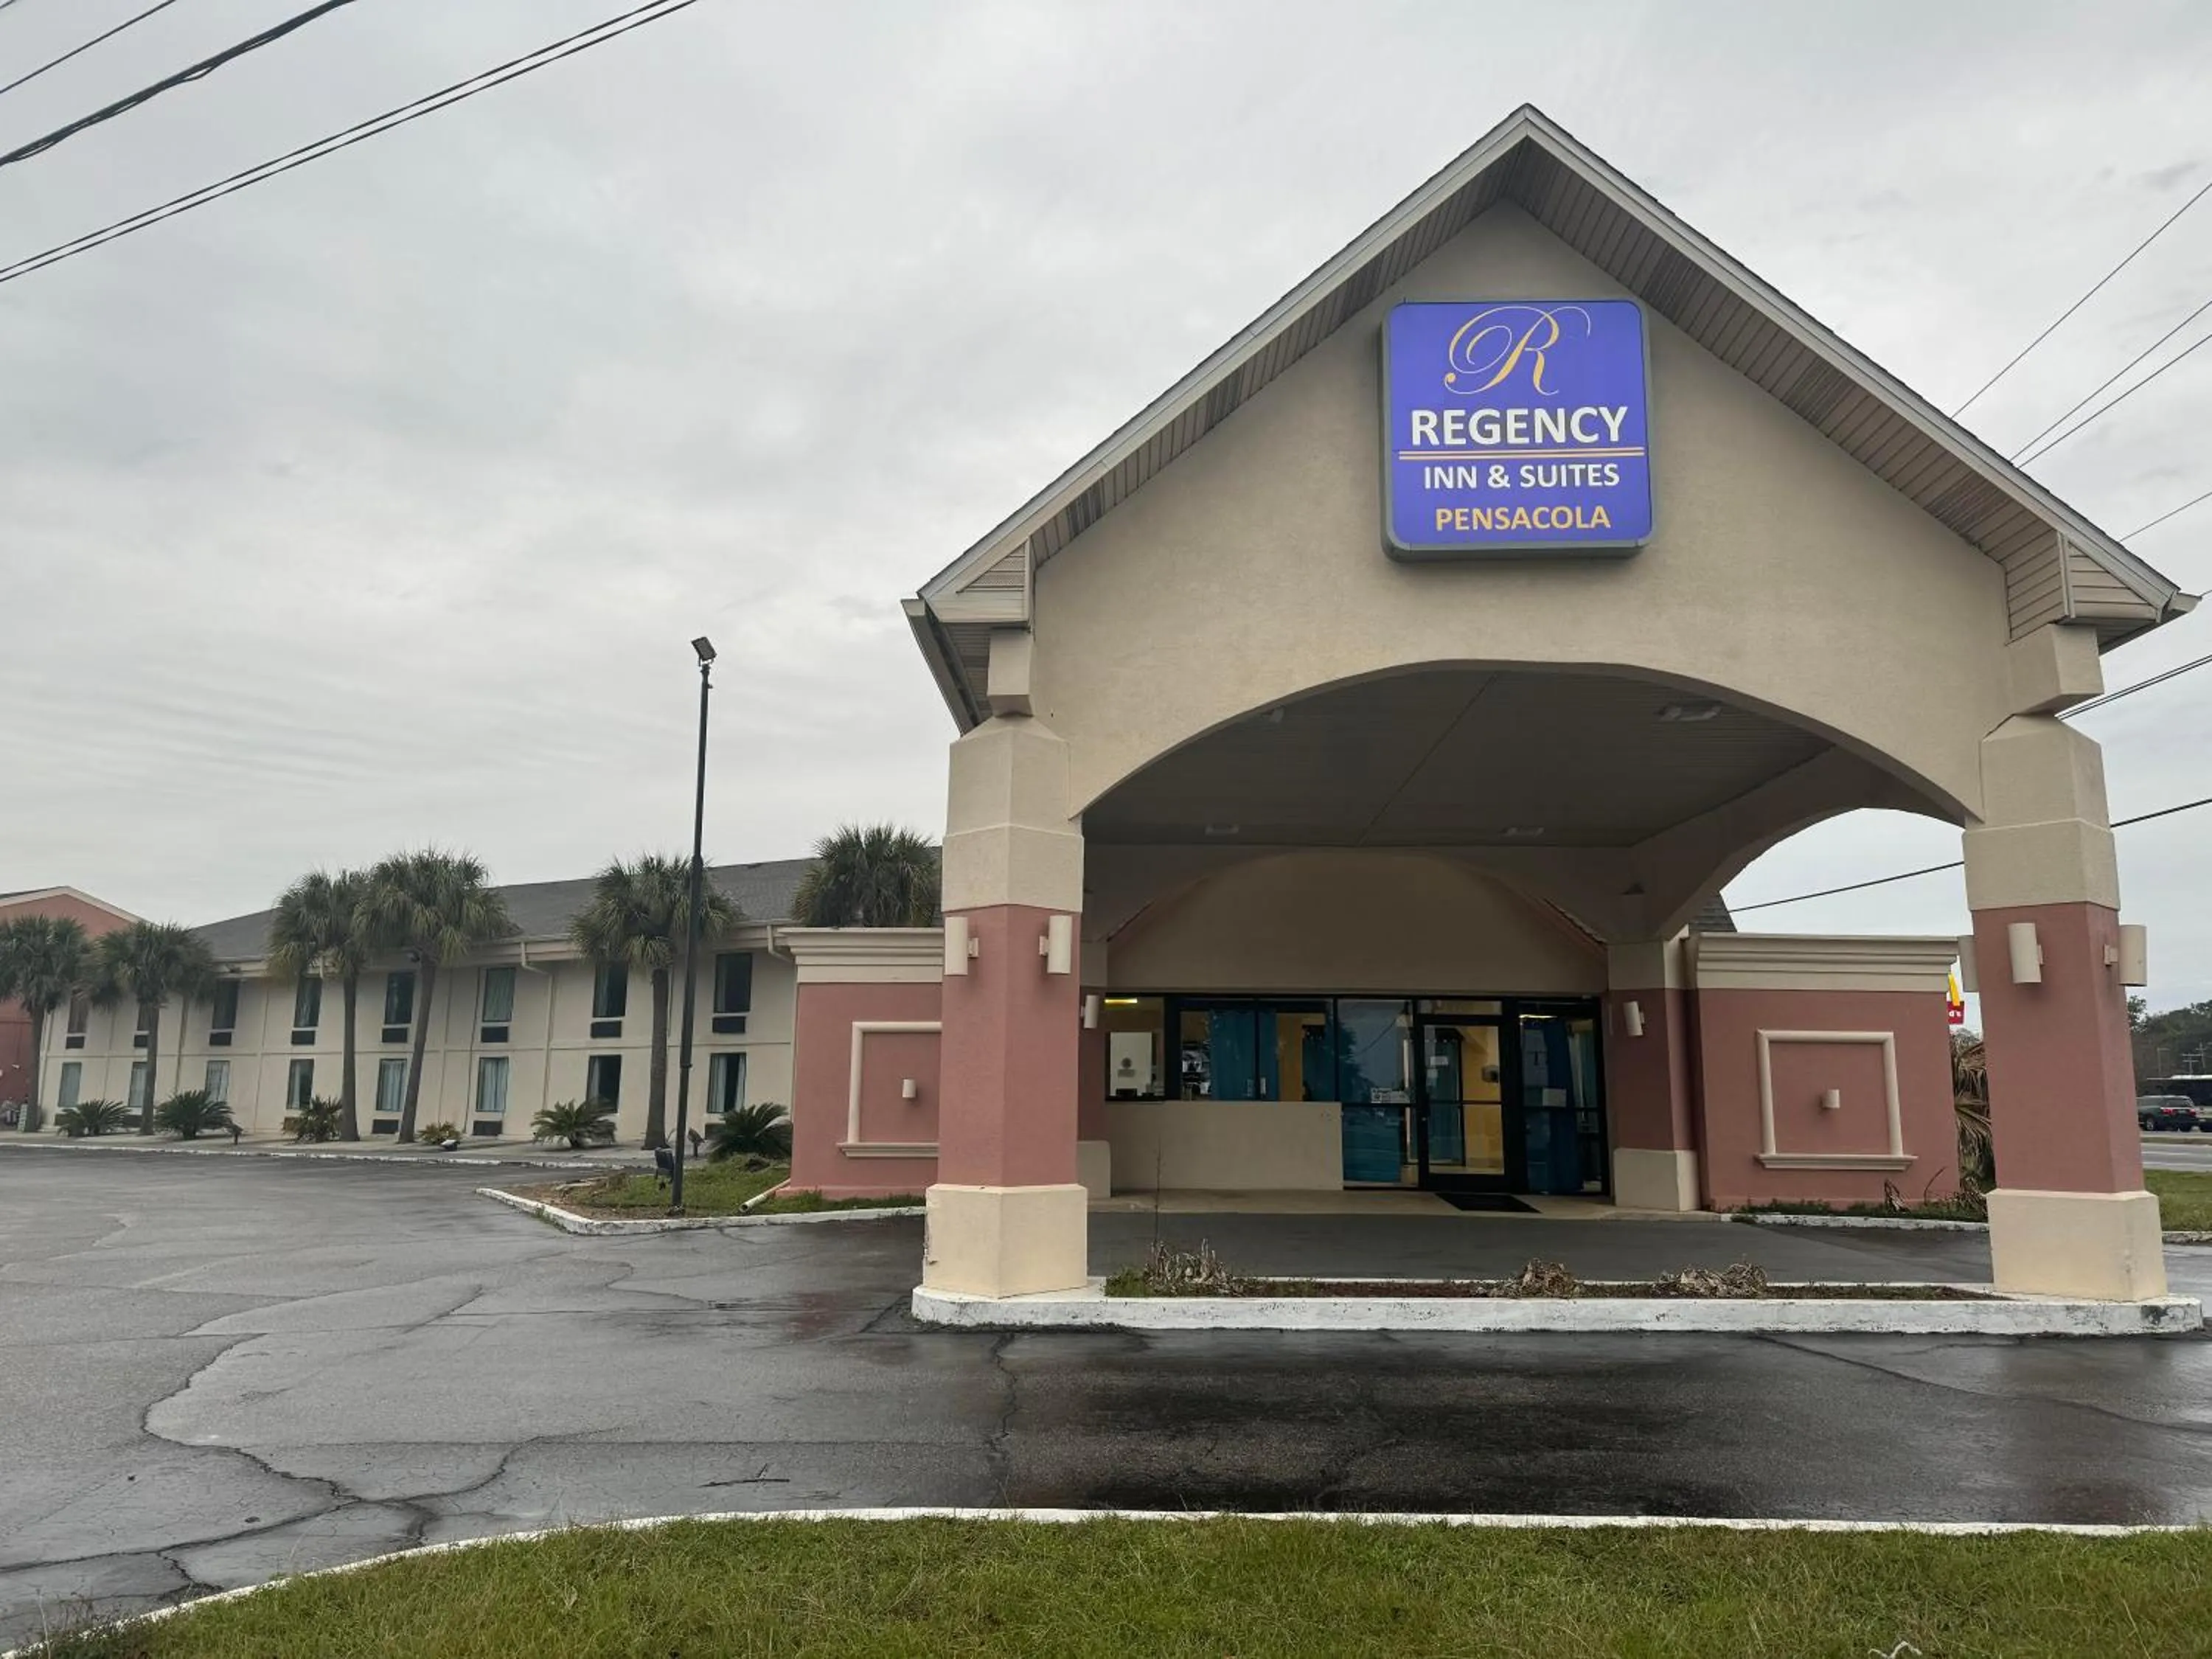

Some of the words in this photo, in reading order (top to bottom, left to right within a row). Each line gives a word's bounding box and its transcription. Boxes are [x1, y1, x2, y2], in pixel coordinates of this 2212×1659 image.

[1444, 305, 1590, 396] R
[1411, 406, 1628, 446] REGENCY
[1424, 465, 1477, 490] INN
[1487, 465, 1511, 488] &
[1520, 462, 1621, 488] SUITES
[1435, 505, 1612, 532] PENSACOLA
